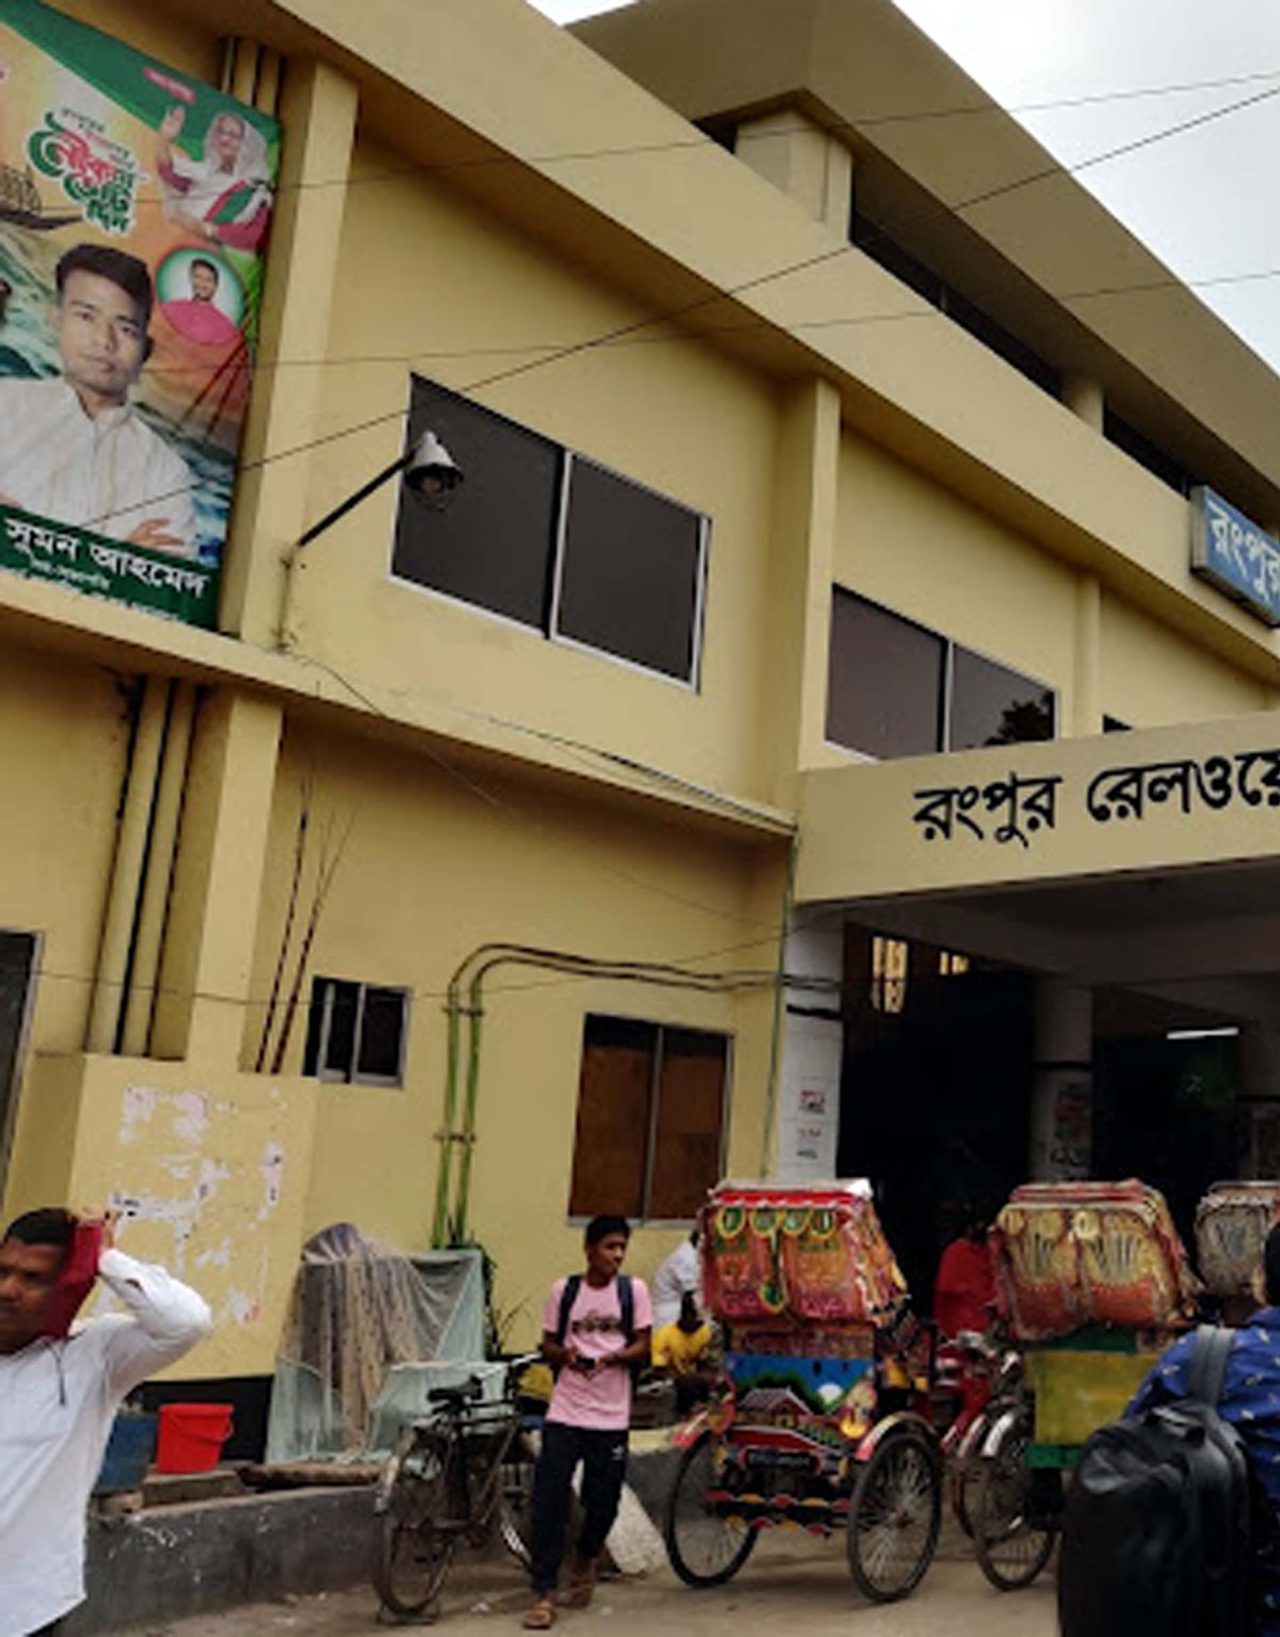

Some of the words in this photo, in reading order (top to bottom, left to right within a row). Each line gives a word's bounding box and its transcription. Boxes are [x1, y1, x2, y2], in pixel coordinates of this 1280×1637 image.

[4, 518, 80, 563] সুমন
[88, 544, 209, 598] আহমেদ
[914, 772, 1062, 848] রংপুর
